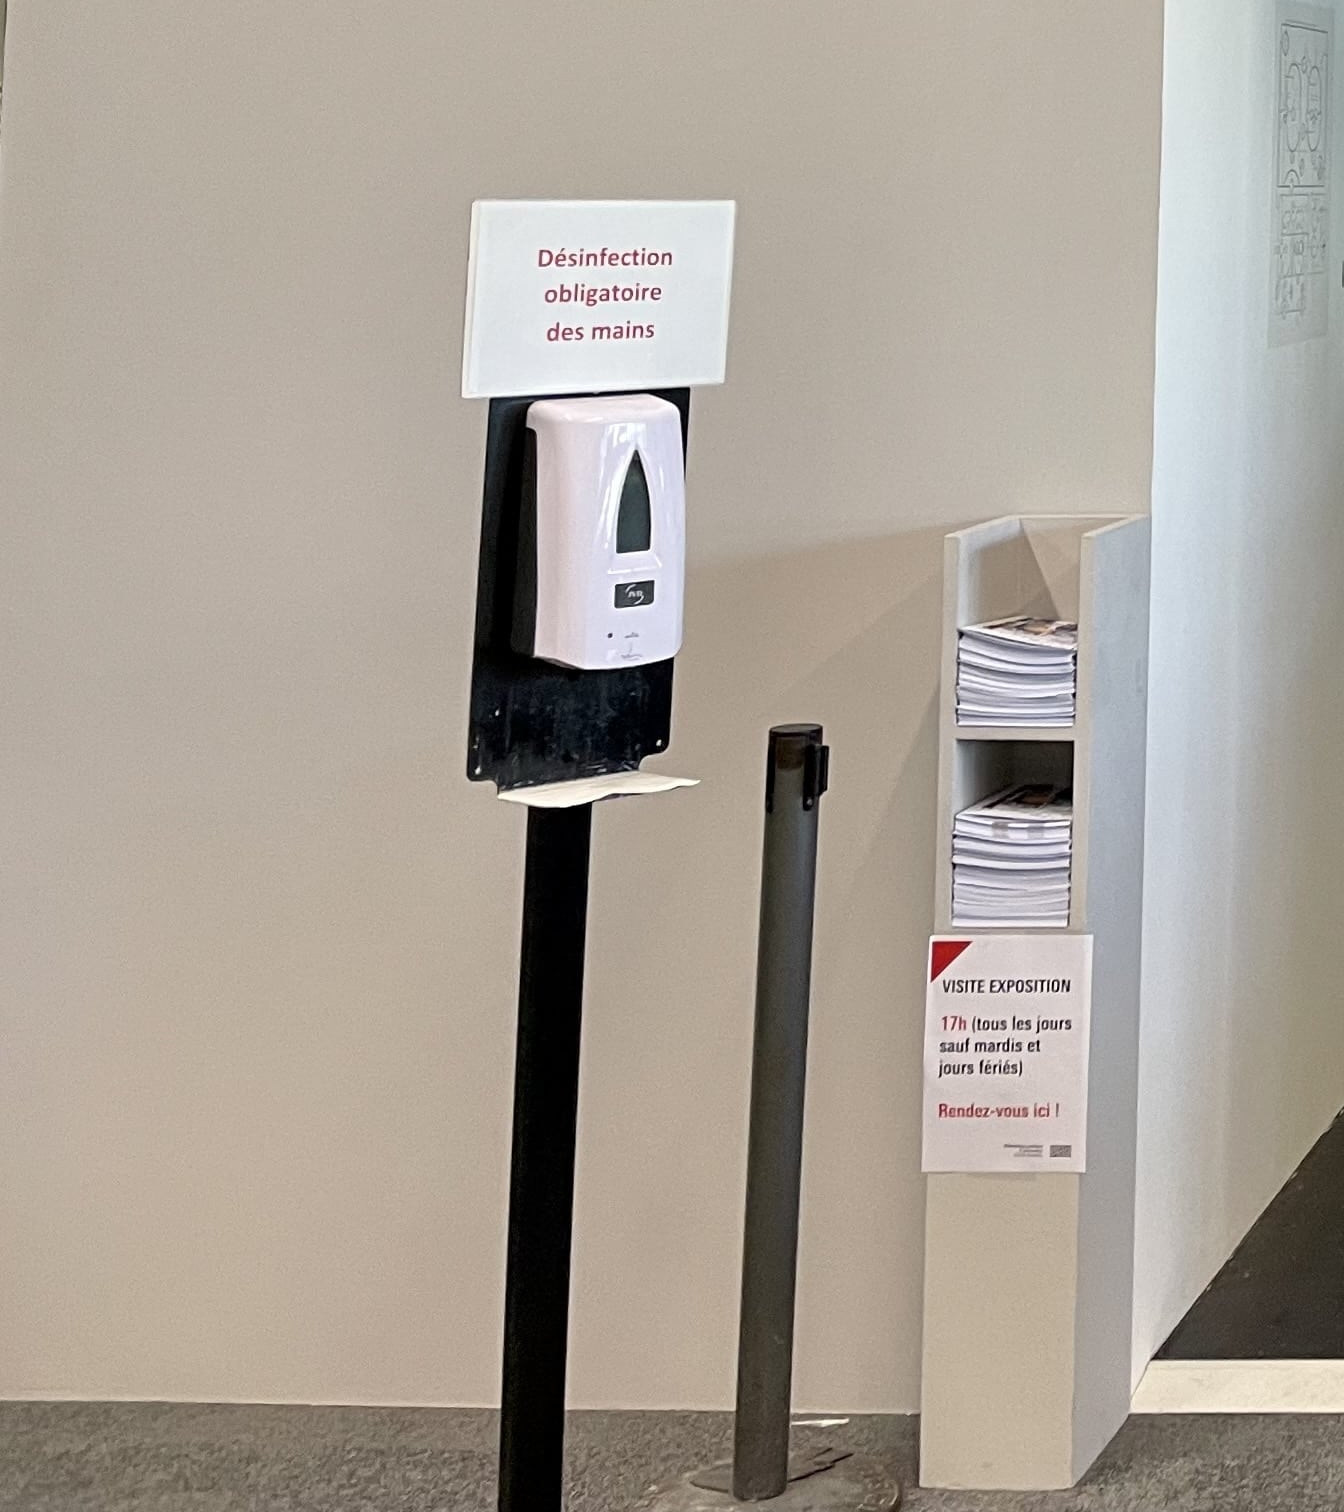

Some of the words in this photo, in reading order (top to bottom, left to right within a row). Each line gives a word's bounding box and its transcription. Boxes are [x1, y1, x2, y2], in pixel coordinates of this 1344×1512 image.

[537, 247, 673, 268] Désinfection
[544, 282, 662, 307] obligatoire
[546, 321, 585, 342] des
[591, 320, 655, 340] mains
[942, 978, 985, 993] VISITE
[989, 978, 1071, 994] EXPOSITION
[941, 1015, 967, 1031] 17h
[971, 1015, 1007, 1034] (tous
[1012, 1015, 1032, 1031] les
[1036, 1015, 1072, 1034] jours
[939, 1037, 970, 1053] sauf
[974, 1037, 1022, 1053] mardis
[1027, 1039, 1041, 1053] et
[938, 1060, 974, 1078] jours
[979, 1059, 1023, 1077] fériés)
[938, 1102, 1029, 1118] Rendez-vous
[1033, 1102, 1050, 1118] ici
